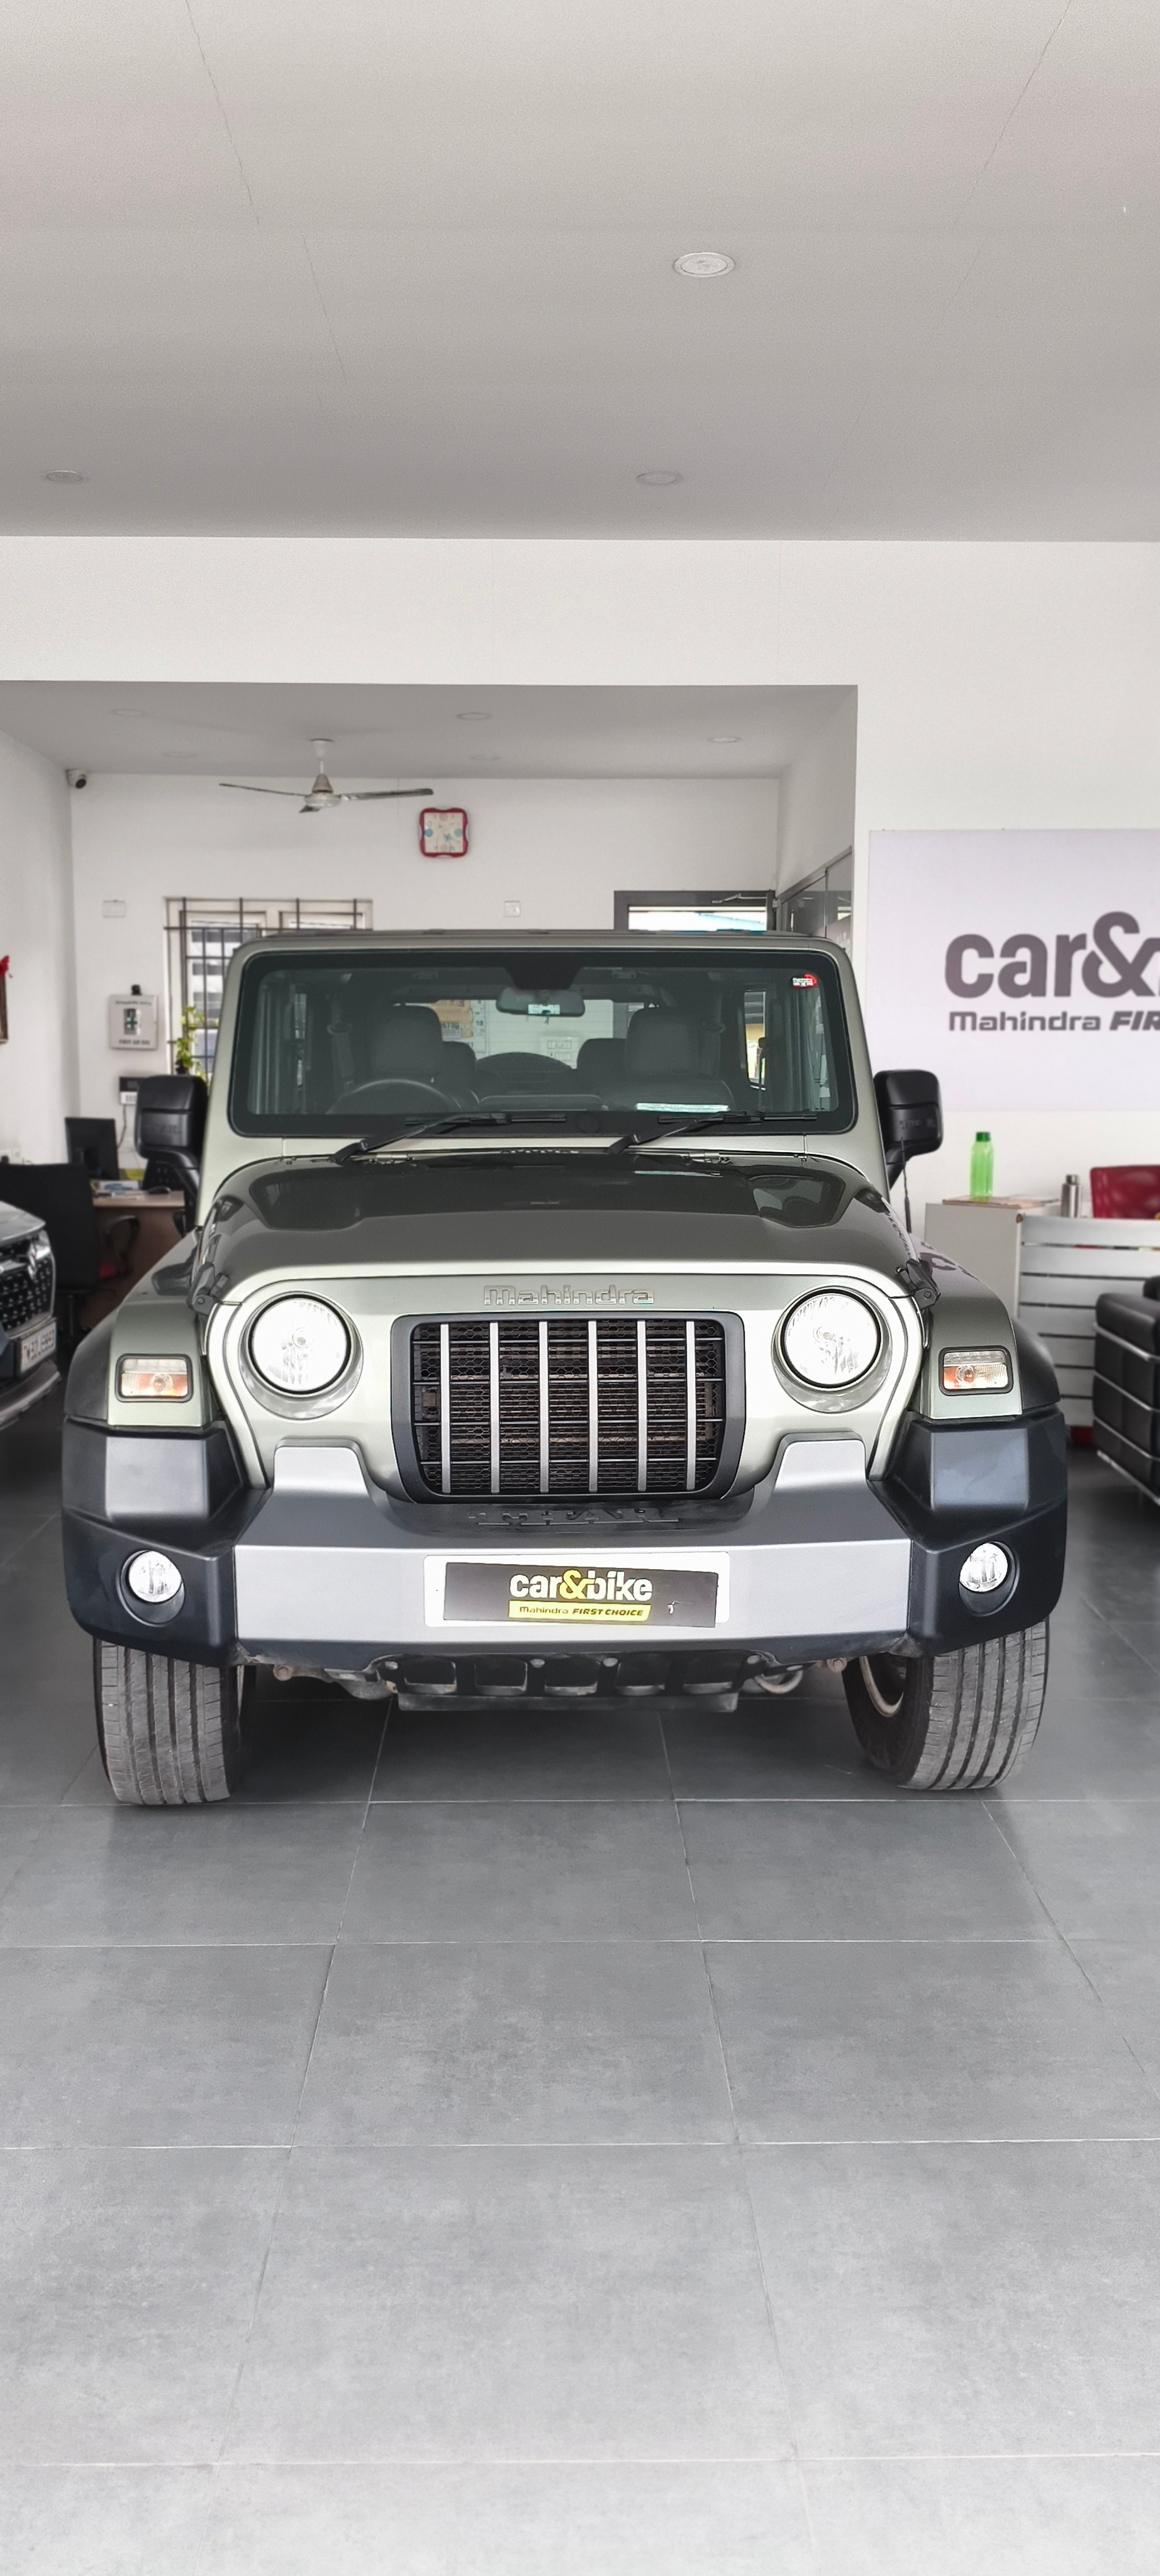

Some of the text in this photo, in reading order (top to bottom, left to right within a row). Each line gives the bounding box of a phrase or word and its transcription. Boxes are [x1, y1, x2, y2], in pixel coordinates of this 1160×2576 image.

[944, 911, 1160, 999] car&
[949, 1011, 1101, 1031] Mahindra
[484, 1284, 654, 1306] Mahindra
[510, 1568, 653, 1602] car&bike
[520, 1606, 569, 1614] Mahindra
[572, 1607, 605, 1616] FIRST
